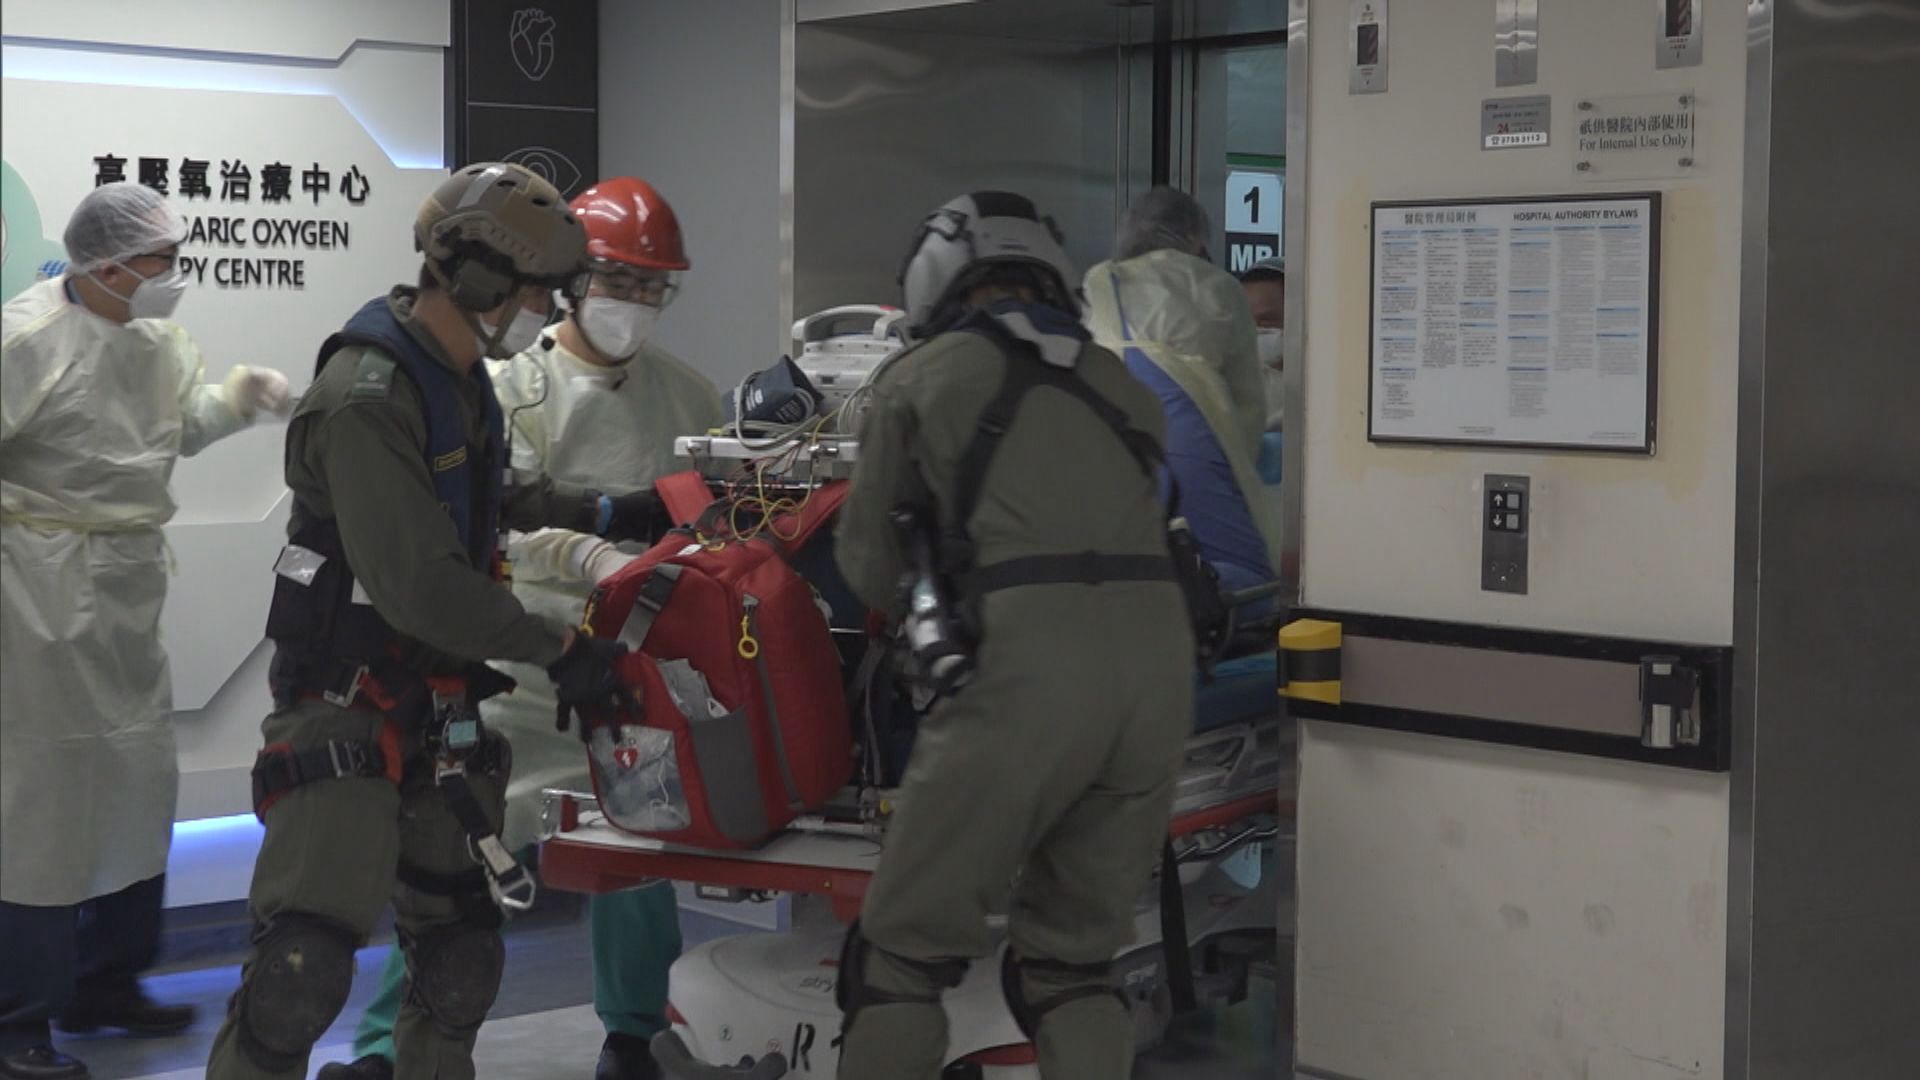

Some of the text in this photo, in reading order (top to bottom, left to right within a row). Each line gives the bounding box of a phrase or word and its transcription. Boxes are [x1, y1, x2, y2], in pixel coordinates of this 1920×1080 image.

[1497, 122, 1509, 134] 24
[1580, 134, 1688, 150] For Internal Use Only
[93, 154, 370, 206] 高壓氧治療中心
[1244, 186, 1259, 223] 1
[1514, 209, 1639, 222] HOSPITAL AUTHORITY BYLAWS
[252, 218, 350, 249] OXYGEN
[214, 257, 305, 287] CENTRE
[791, 1022, 816, 1072] R
